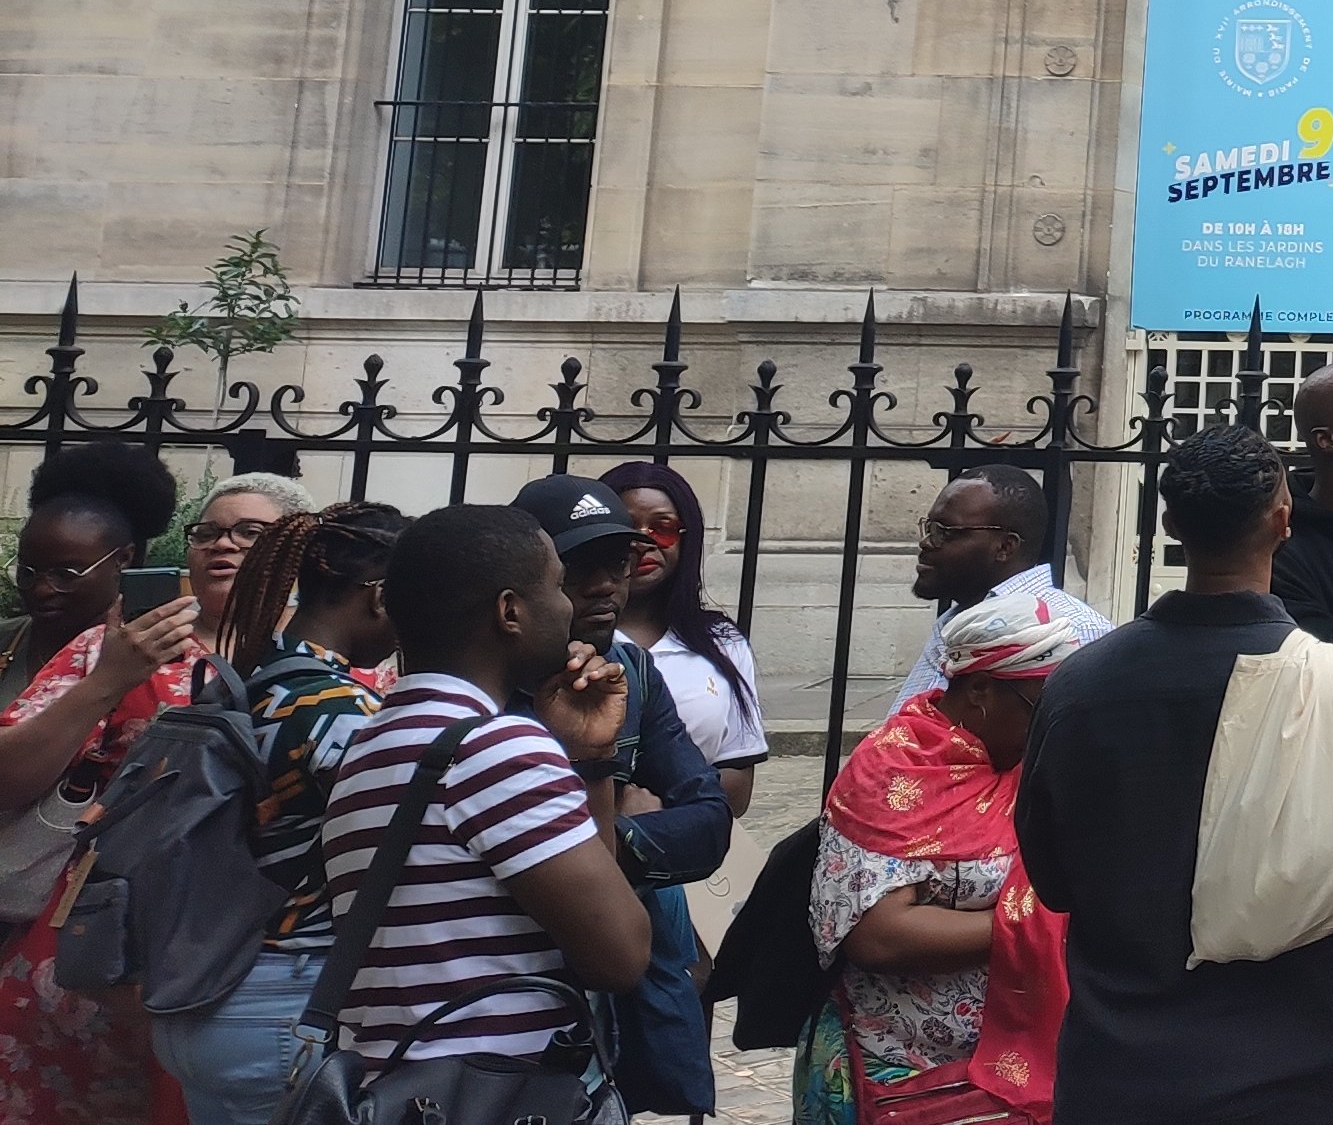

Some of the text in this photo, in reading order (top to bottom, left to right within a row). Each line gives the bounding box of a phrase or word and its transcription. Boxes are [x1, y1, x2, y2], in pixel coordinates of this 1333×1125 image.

[1212, 47, 1222, 64] DU
[1232, 0, 1313, 49] ARRONDISSEMENT
[1299, 57, 1311, 73] DE
[1174, 140, 1290, 181] SAMEDI
[1167, 161, 1331, 204] SEPTEMBRE
[1202, 219, 1304, 236] DE 10H À 18H
[1182, 239, 1324, 253] DANS LES JARDINS
[1197, 255, 1307, 269] DU RANELAGH
[570, 506, 611, 520] adidas
